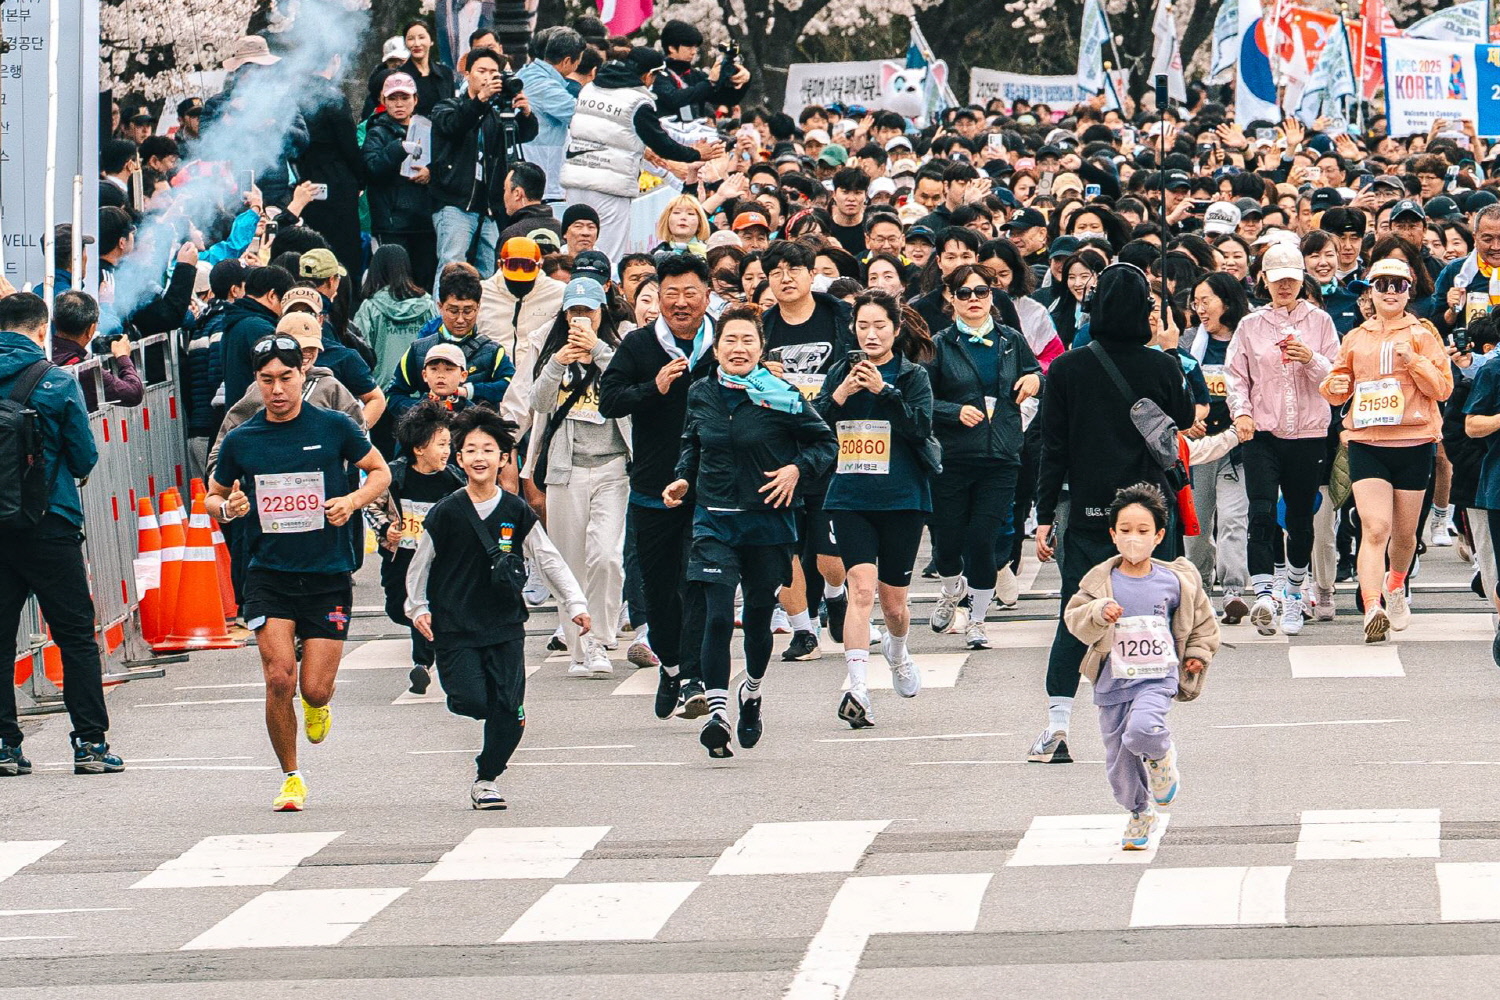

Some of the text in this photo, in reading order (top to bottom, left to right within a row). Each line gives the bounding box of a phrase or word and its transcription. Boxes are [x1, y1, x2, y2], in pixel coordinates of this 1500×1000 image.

[1419, 60, 1442, 73] 2025
[1395, 75, 1444, 100] KOREA
[1359, 395, 1399, 412] 51598
[842, 439, 885, 455] 50860
[262, 494, 319, 512] 22869
